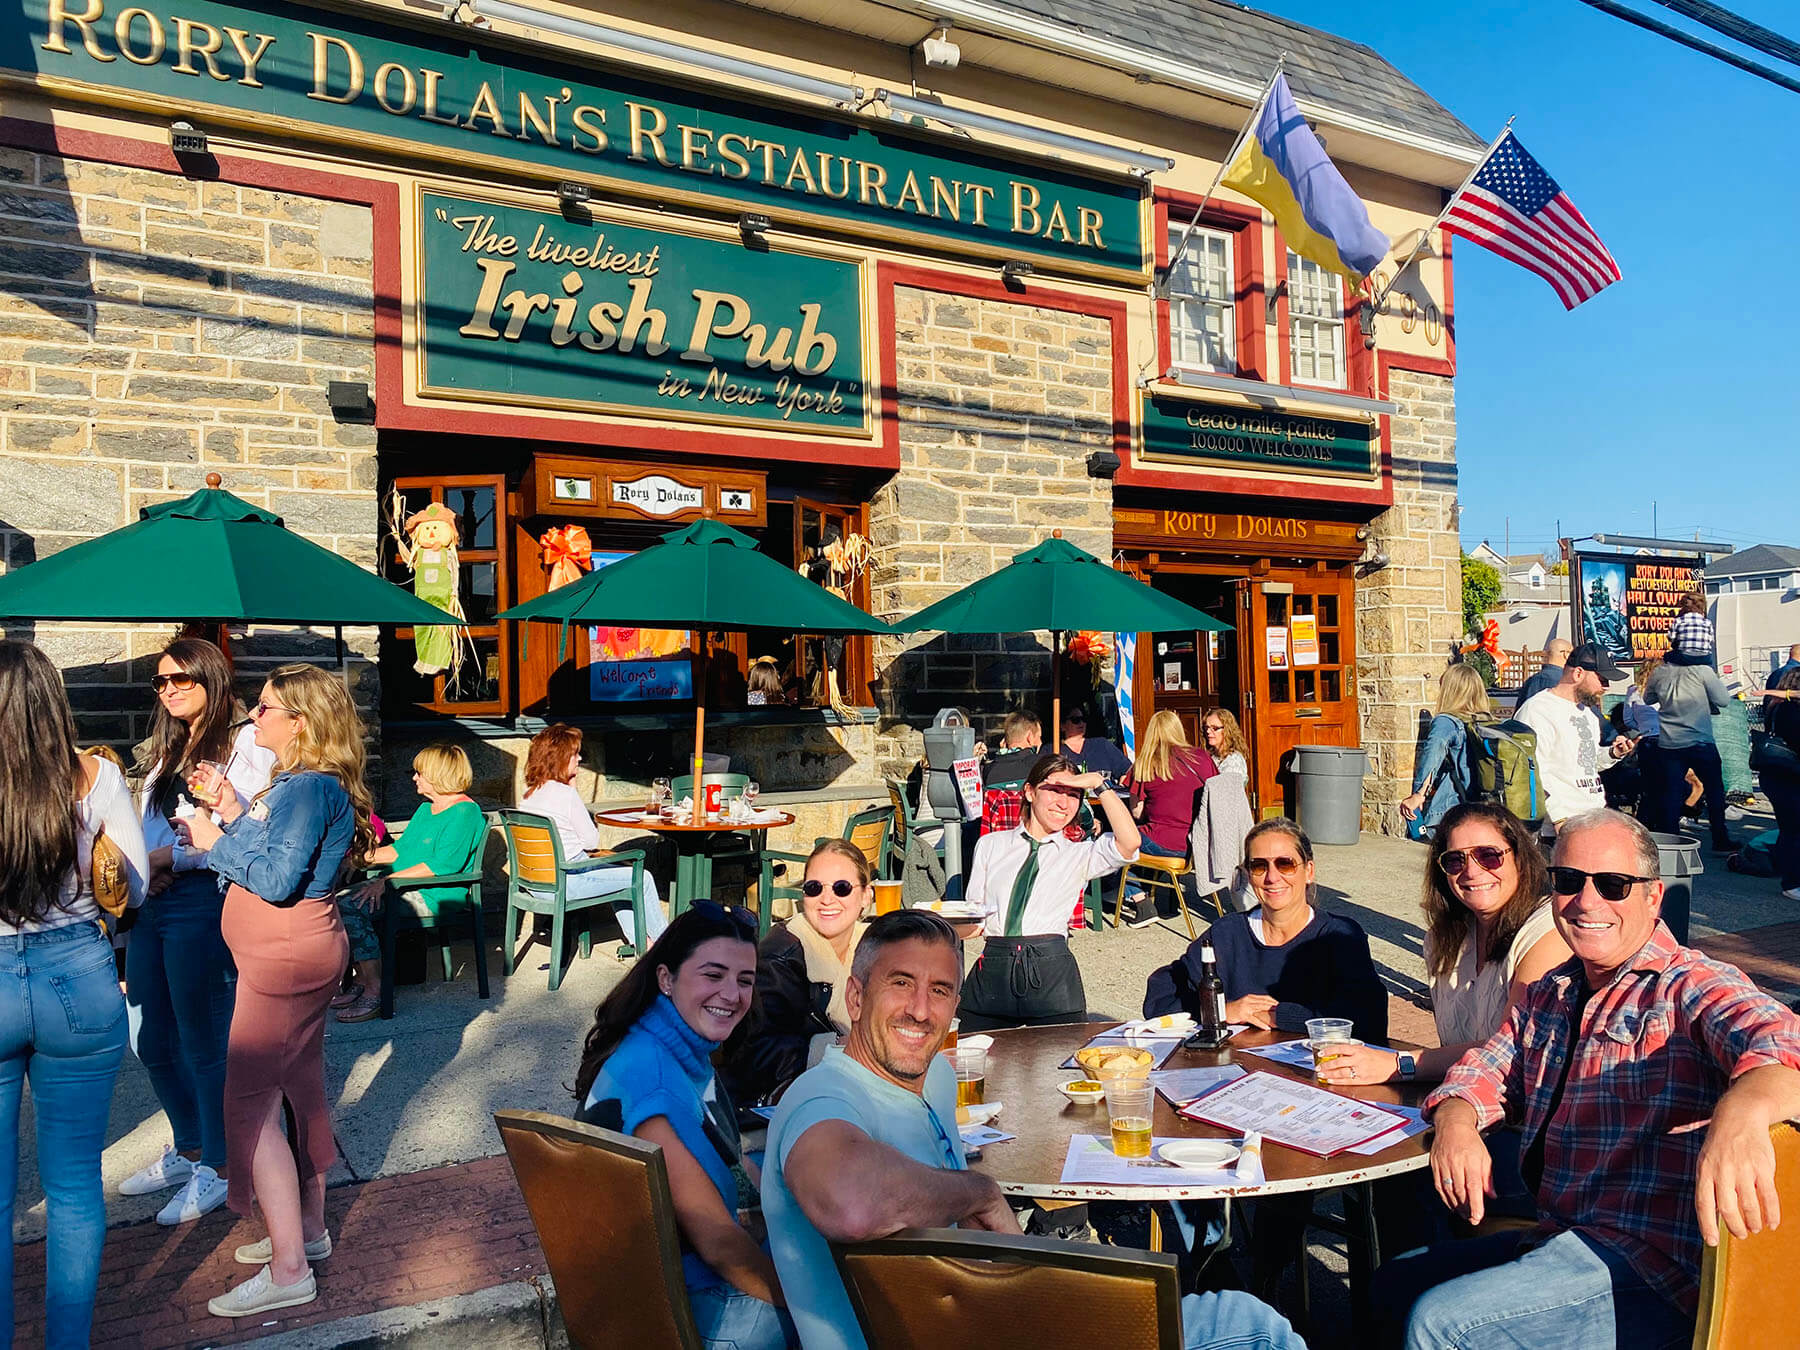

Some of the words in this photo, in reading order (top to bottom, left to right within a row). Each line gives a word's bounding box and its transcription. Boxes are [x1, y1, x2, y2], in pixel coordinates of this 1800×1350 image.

[40, 0, 276, 88] RORY
[305, 31, 607, 154] DOLAN'S
[624, 101, 995, 227] RESTAURANT
[1009, 180, 1108, 250] BAR
[527, 223, 660, 277] liveliest
[459, 256, 671, 357] Irish
[679, 288, 838, 376] Pub
[657, 369, 693, 398] in
[699, 366, 766, 407] New
[1190, 432, 1245, 453] 100,000
[1249, 437, 1334, 462] WELCOMES
[618, 485, 650, 501] Rory
[656, 487, 696, 503] Dolan's
[1163, 510, 1217, 539] Rory
[1636, 565, 1657, 578] RORY
[1627, 590, 1684, 606] HALLOW
[1636, 606, 1682, 616] PART
